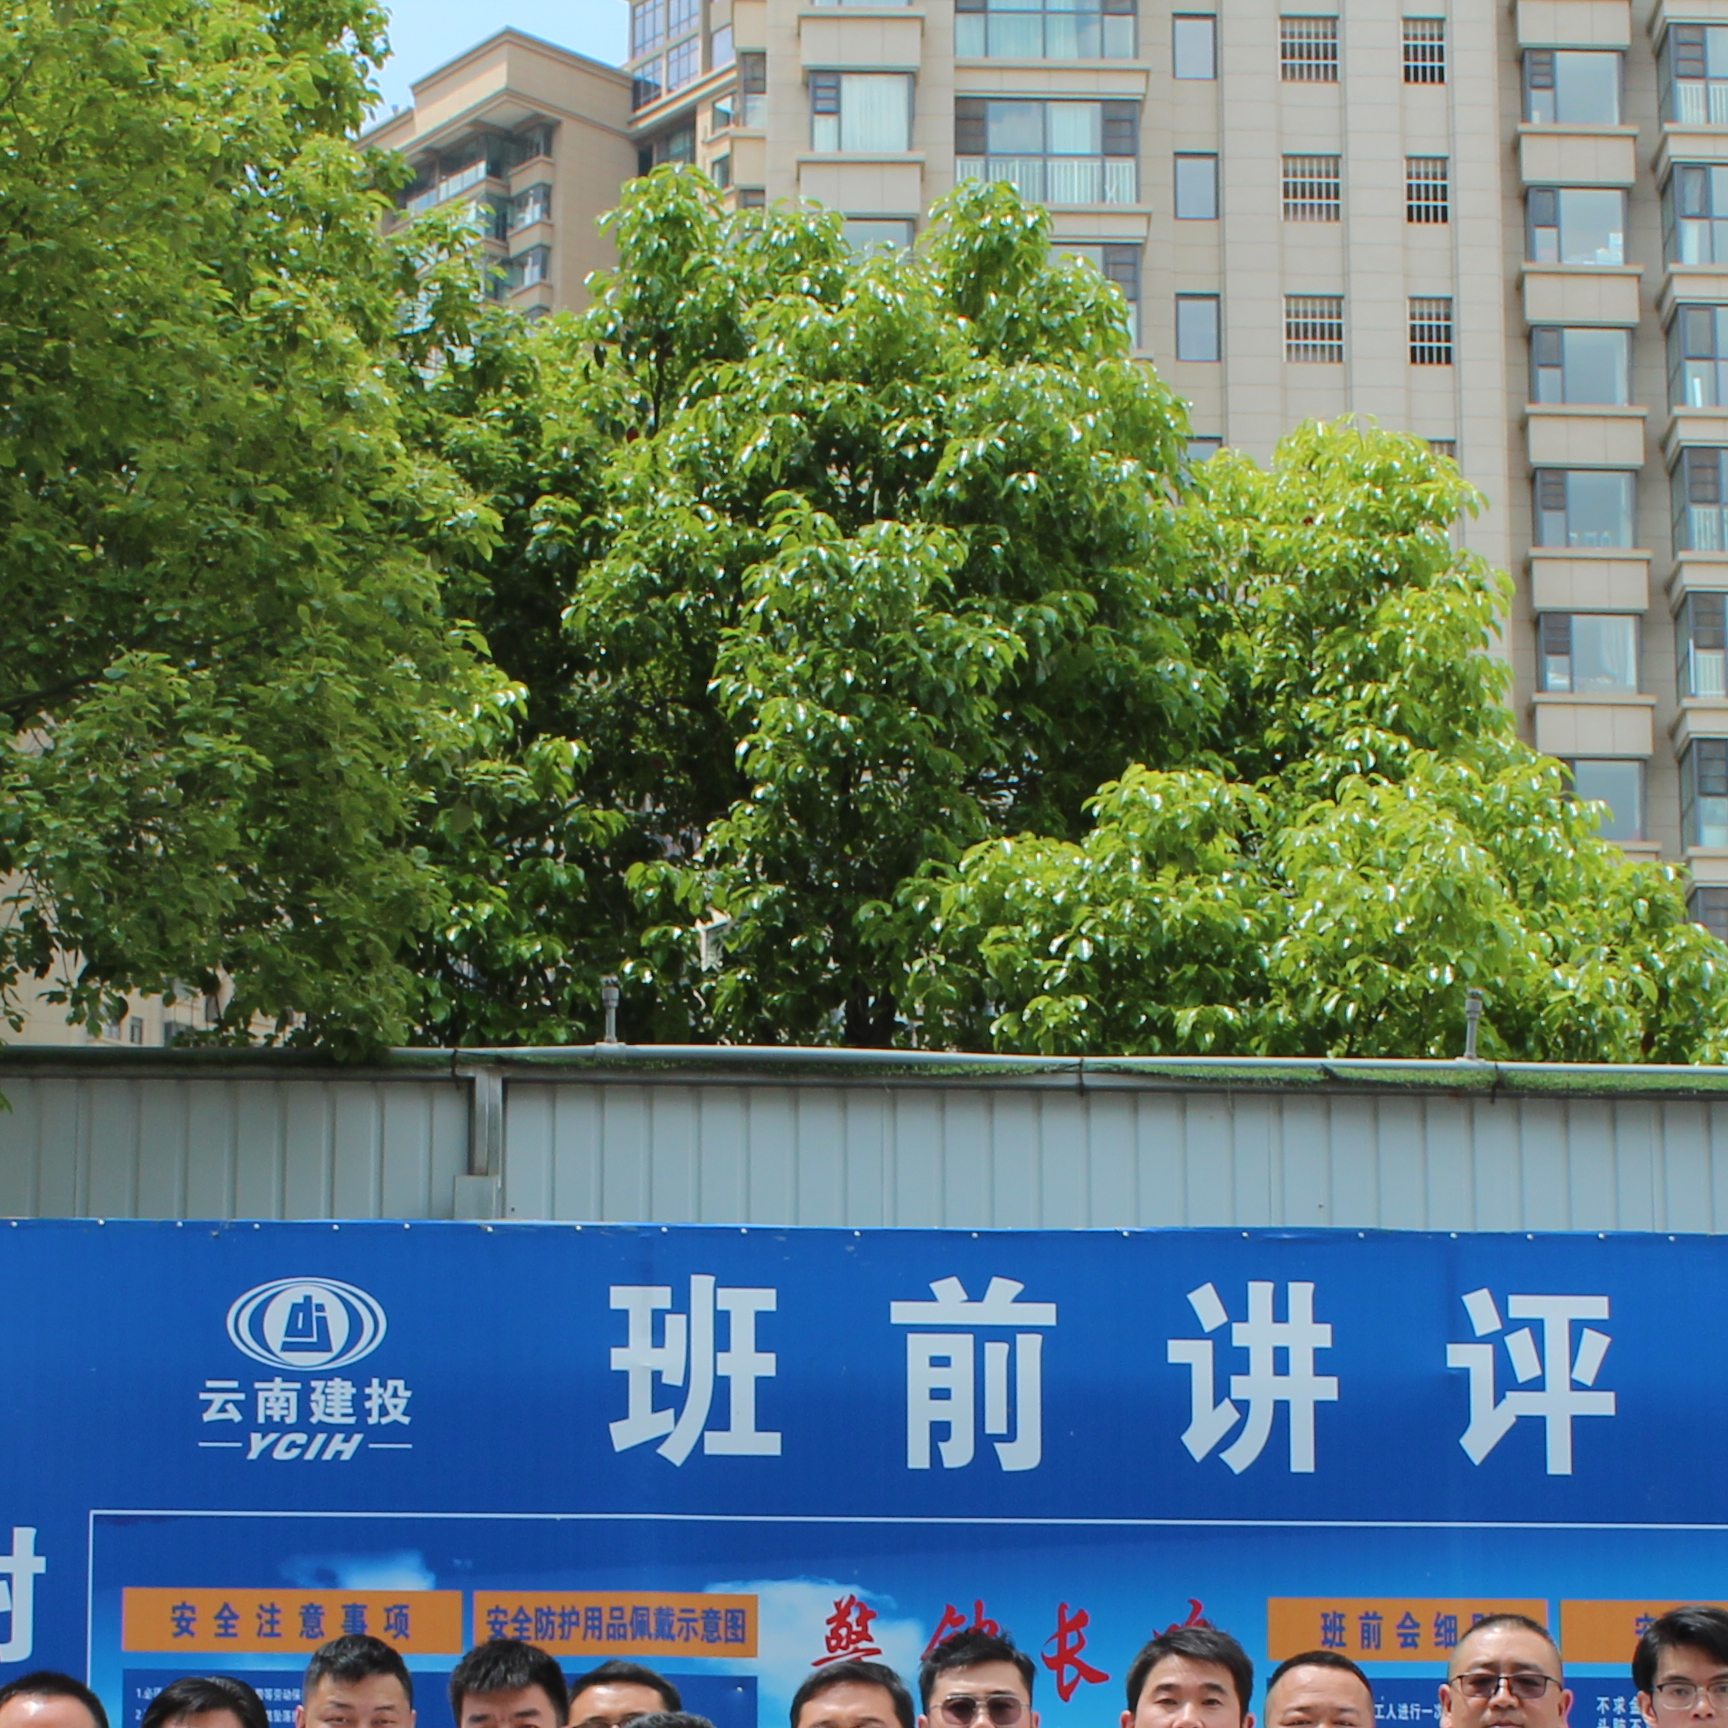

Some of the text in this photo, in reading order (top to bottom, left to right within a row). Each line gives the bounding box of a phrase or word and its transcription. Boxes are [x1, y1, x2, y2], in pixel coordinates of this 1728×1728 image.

[199, 1378, 413, 1426] 云南建投
[246, 1432, 364, 1461] YCIH
[171, 1601, 410, 1640] 安全注意事项
[486, 1605, 746, 1644] 安全防护用品佩戴示意图
[1321, 1611, 1494, 1649] 班前会细
